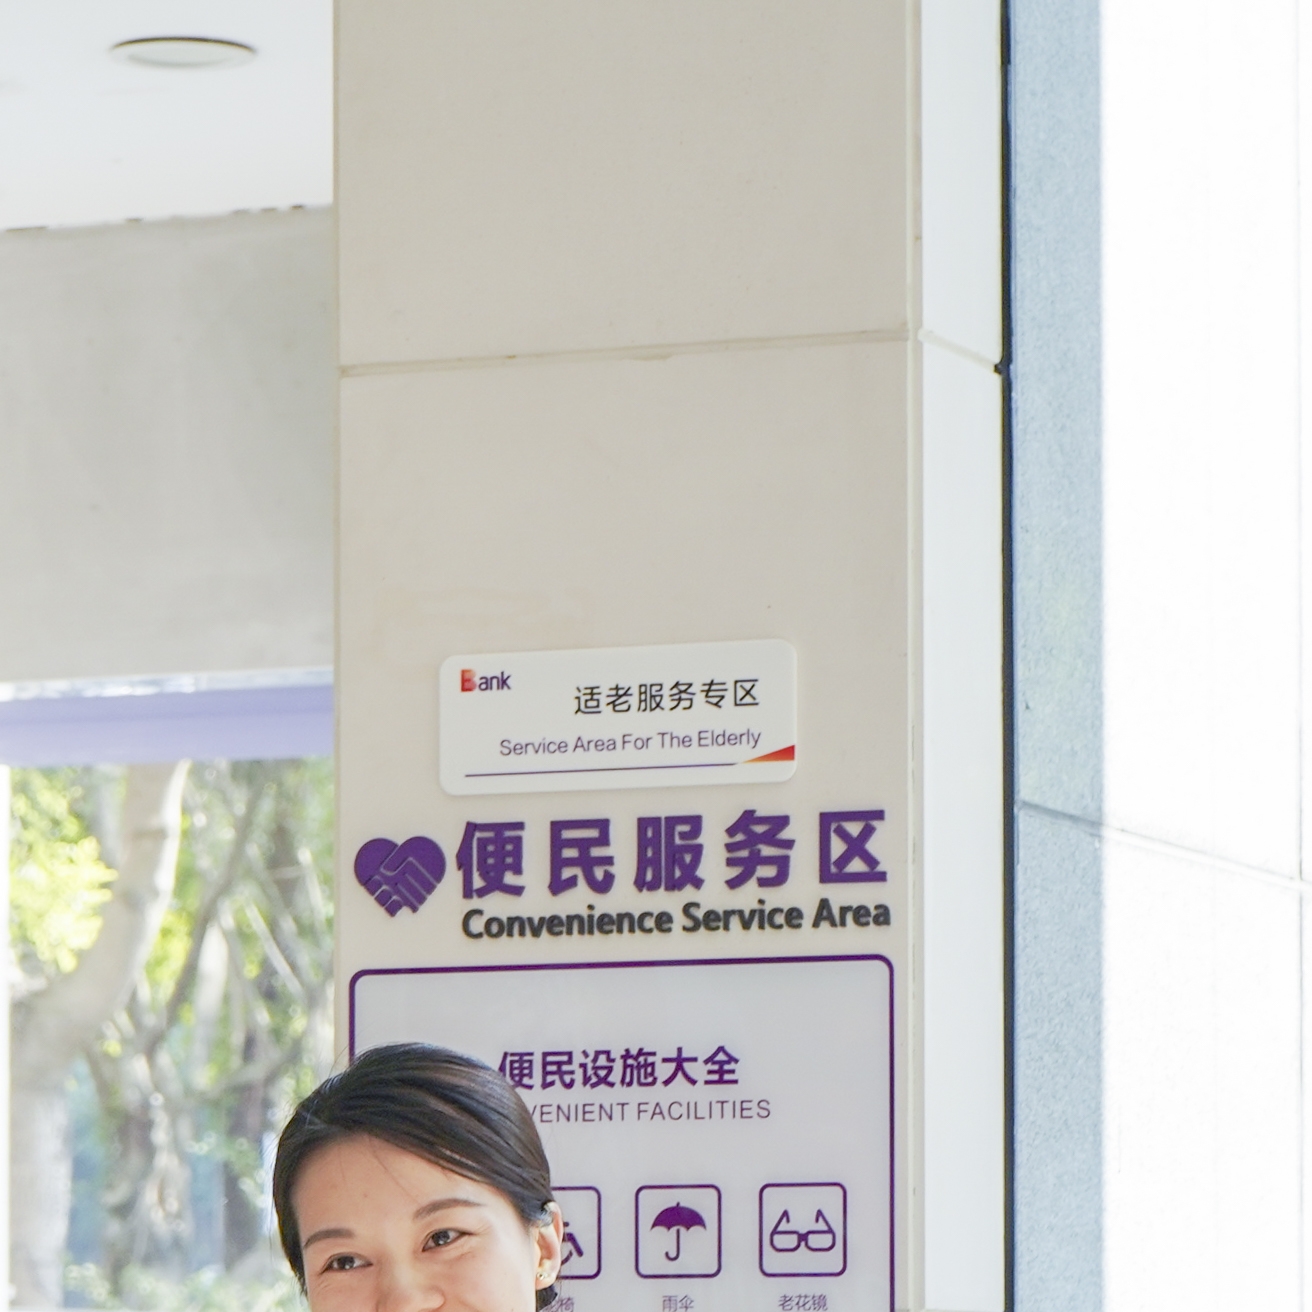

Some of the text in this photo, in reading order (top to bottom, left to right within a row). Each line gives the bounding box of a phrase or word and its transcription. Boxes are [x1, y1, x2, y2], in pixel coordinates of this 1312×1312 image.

[460, 669, 511, 692] Bank
[574, 679, 760, 715] 适老服务专区
[500, 728, 761, 756] Service Area For The Elderly
[456, 810, 887, 900] 便民服务区
[462, 898, 891, 939] Convenience Service Area
[498, 1045, 740, 1090] 便民设施大全
[530, 1099, 772, 1124] ENIENT FACILITIES
[662, 1294, 694, 1312] 雨伞
[778, 1294, 828, 1311] 老花镜
